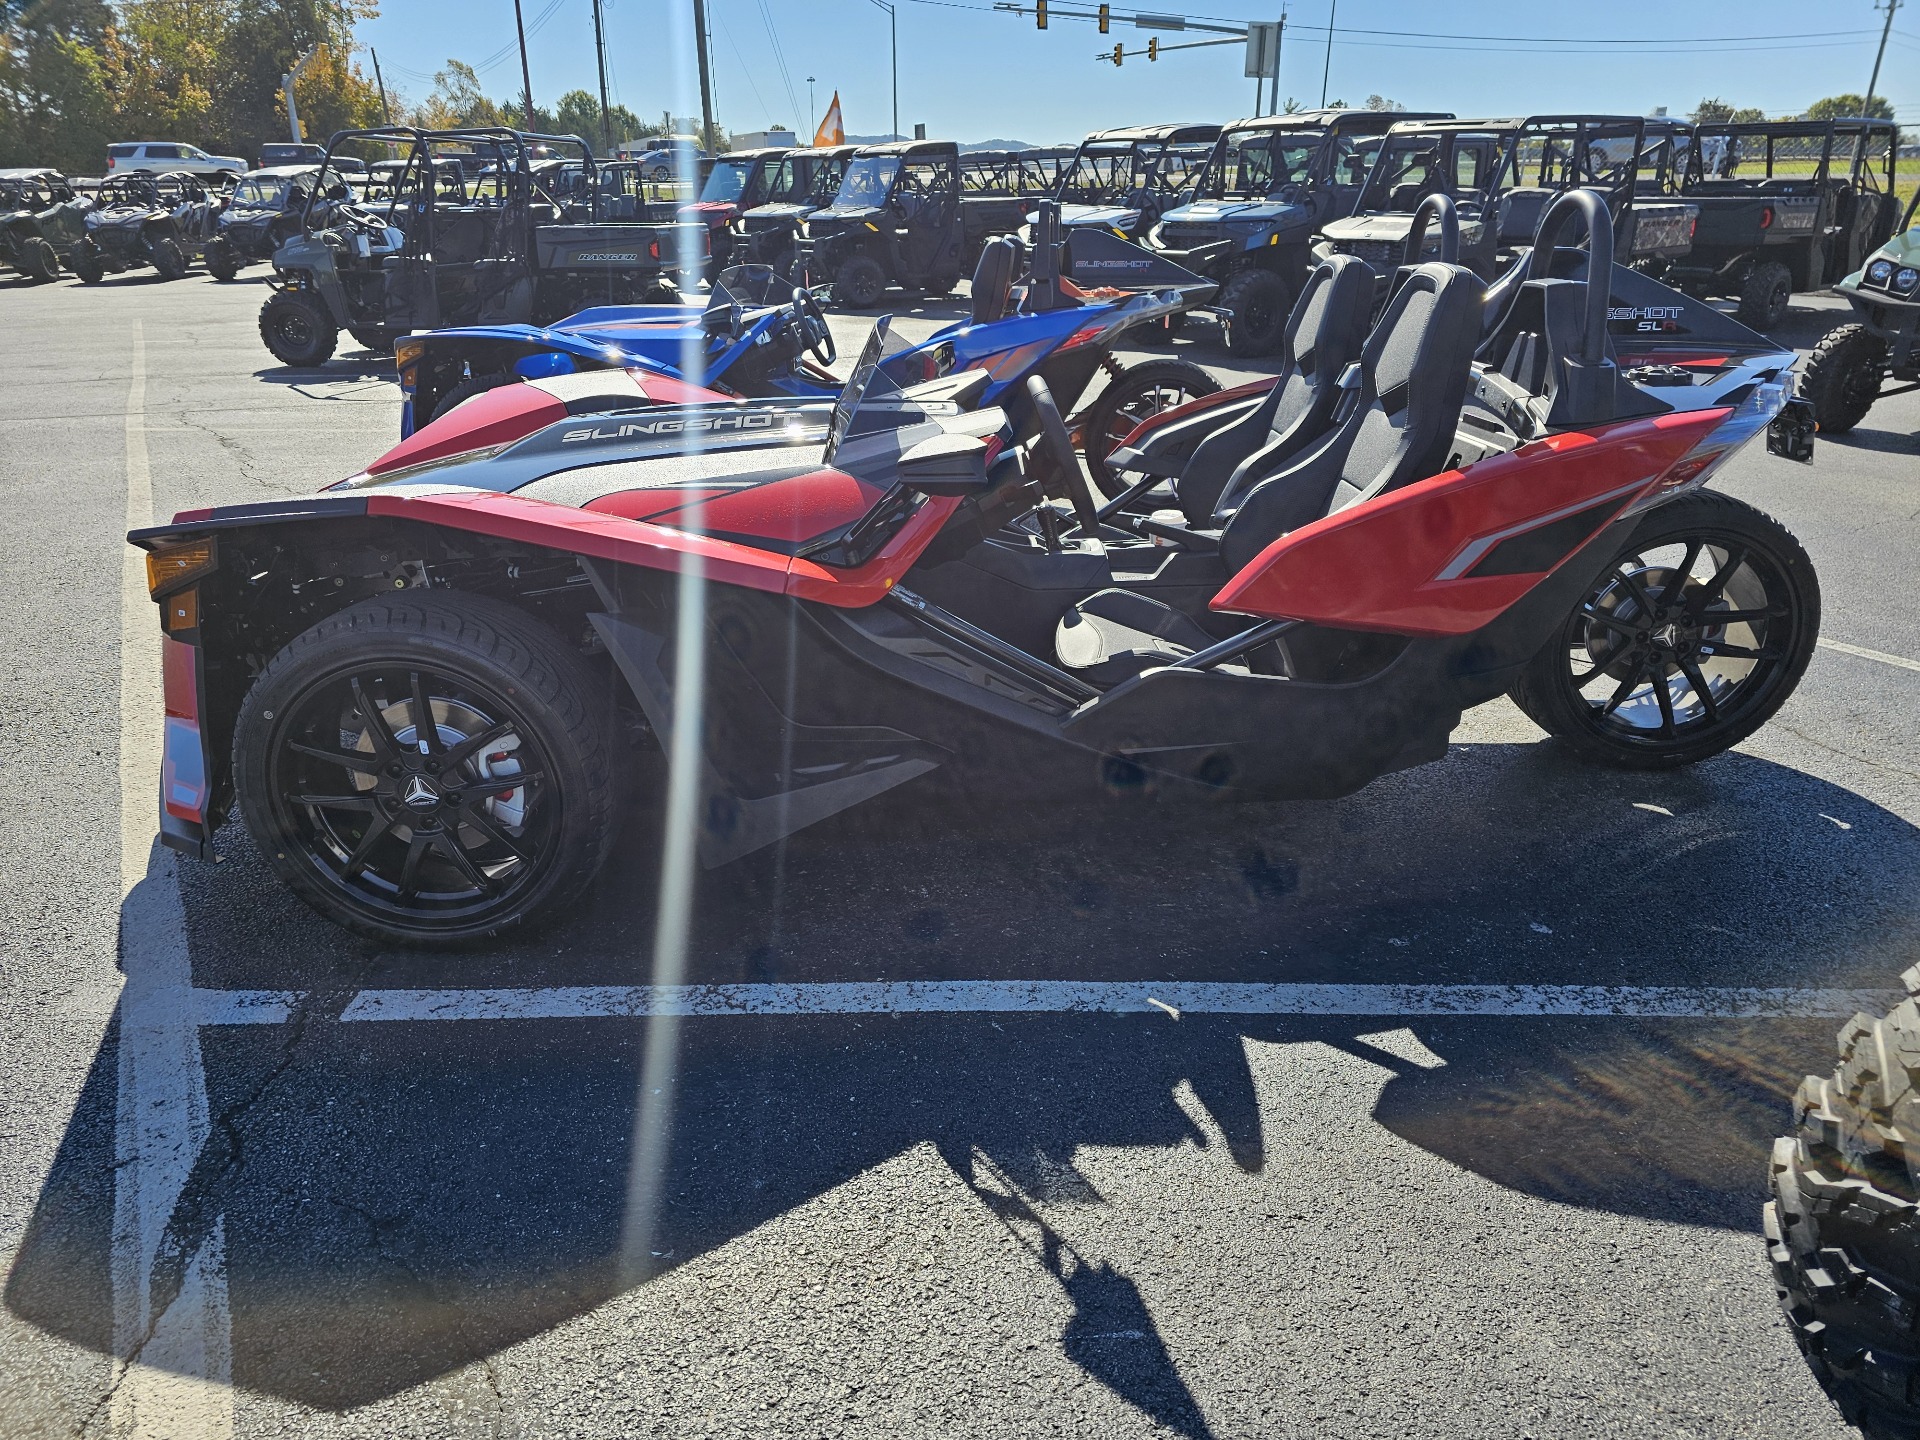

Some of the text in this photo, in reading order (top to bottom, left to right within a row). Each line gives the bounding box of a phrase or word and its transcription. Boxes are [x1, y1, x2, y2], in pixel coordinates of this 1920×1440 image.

[577, 253, 637, 261] RANGER
[1075, 260, 1153, 268] SLINGSHOT
[1637, 321, 1677, 332] SLR
[561, 412, 803, 443] SLINGSHOT
